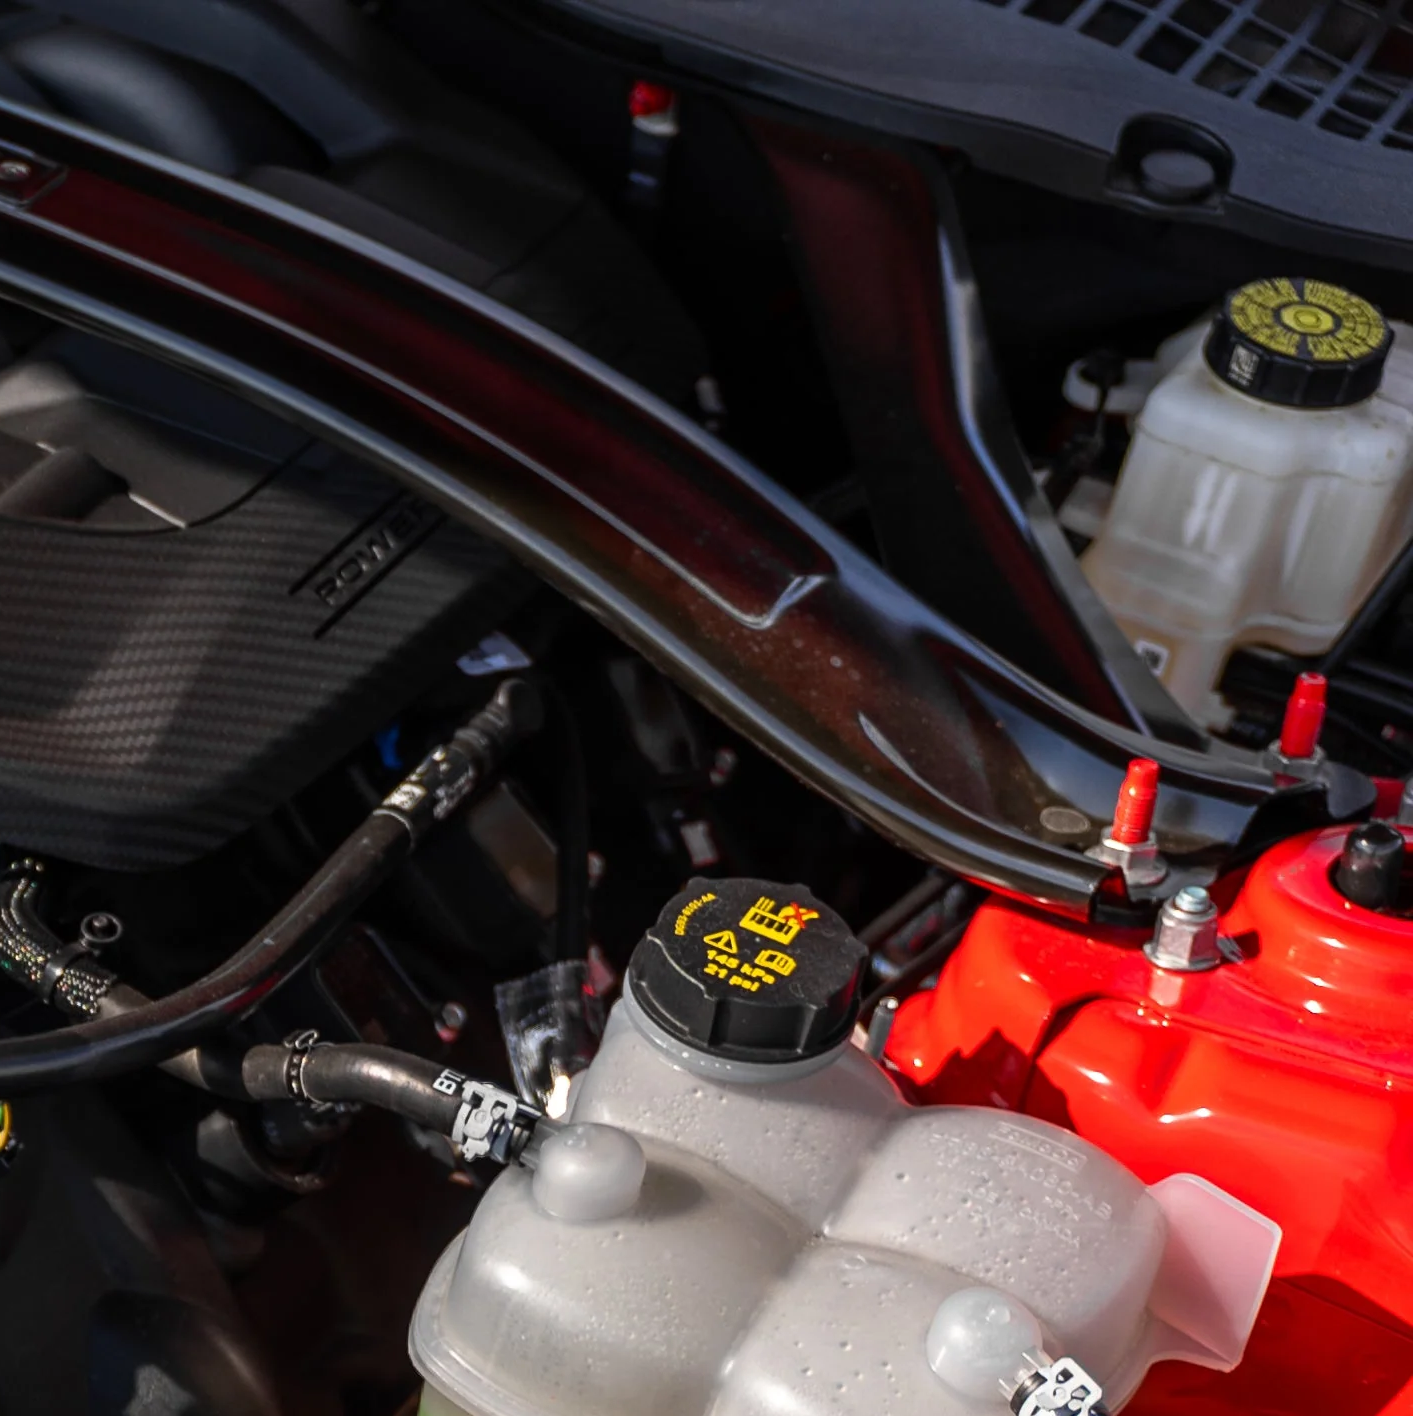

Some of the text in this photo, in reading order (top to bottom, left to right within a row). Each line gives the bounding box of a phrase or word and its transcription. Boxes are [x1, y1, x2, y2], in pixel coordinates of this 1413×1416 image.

[704, 963, 760, 992] 21 psi
[706, 950, 776, 985] 145 kPa
